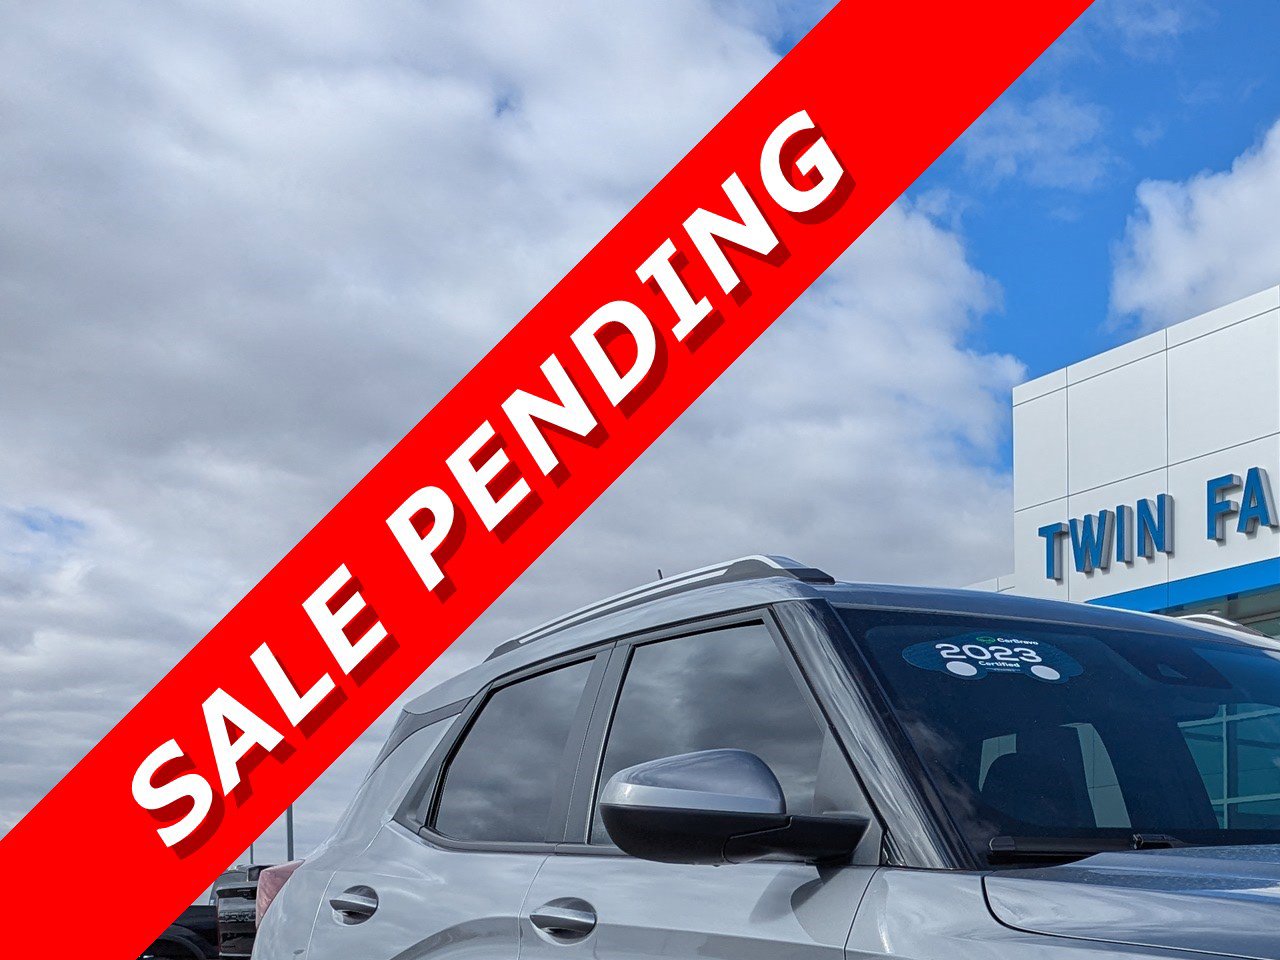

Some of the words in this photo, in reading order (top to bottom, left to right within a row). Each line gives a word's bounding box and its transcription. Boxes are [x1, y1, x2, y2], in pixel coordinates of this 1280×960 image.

[1038, 493, 1175, 581] TWIN
[935, 643, 1042, 663] 2023
[978, 660, 1021, 668] Certified
